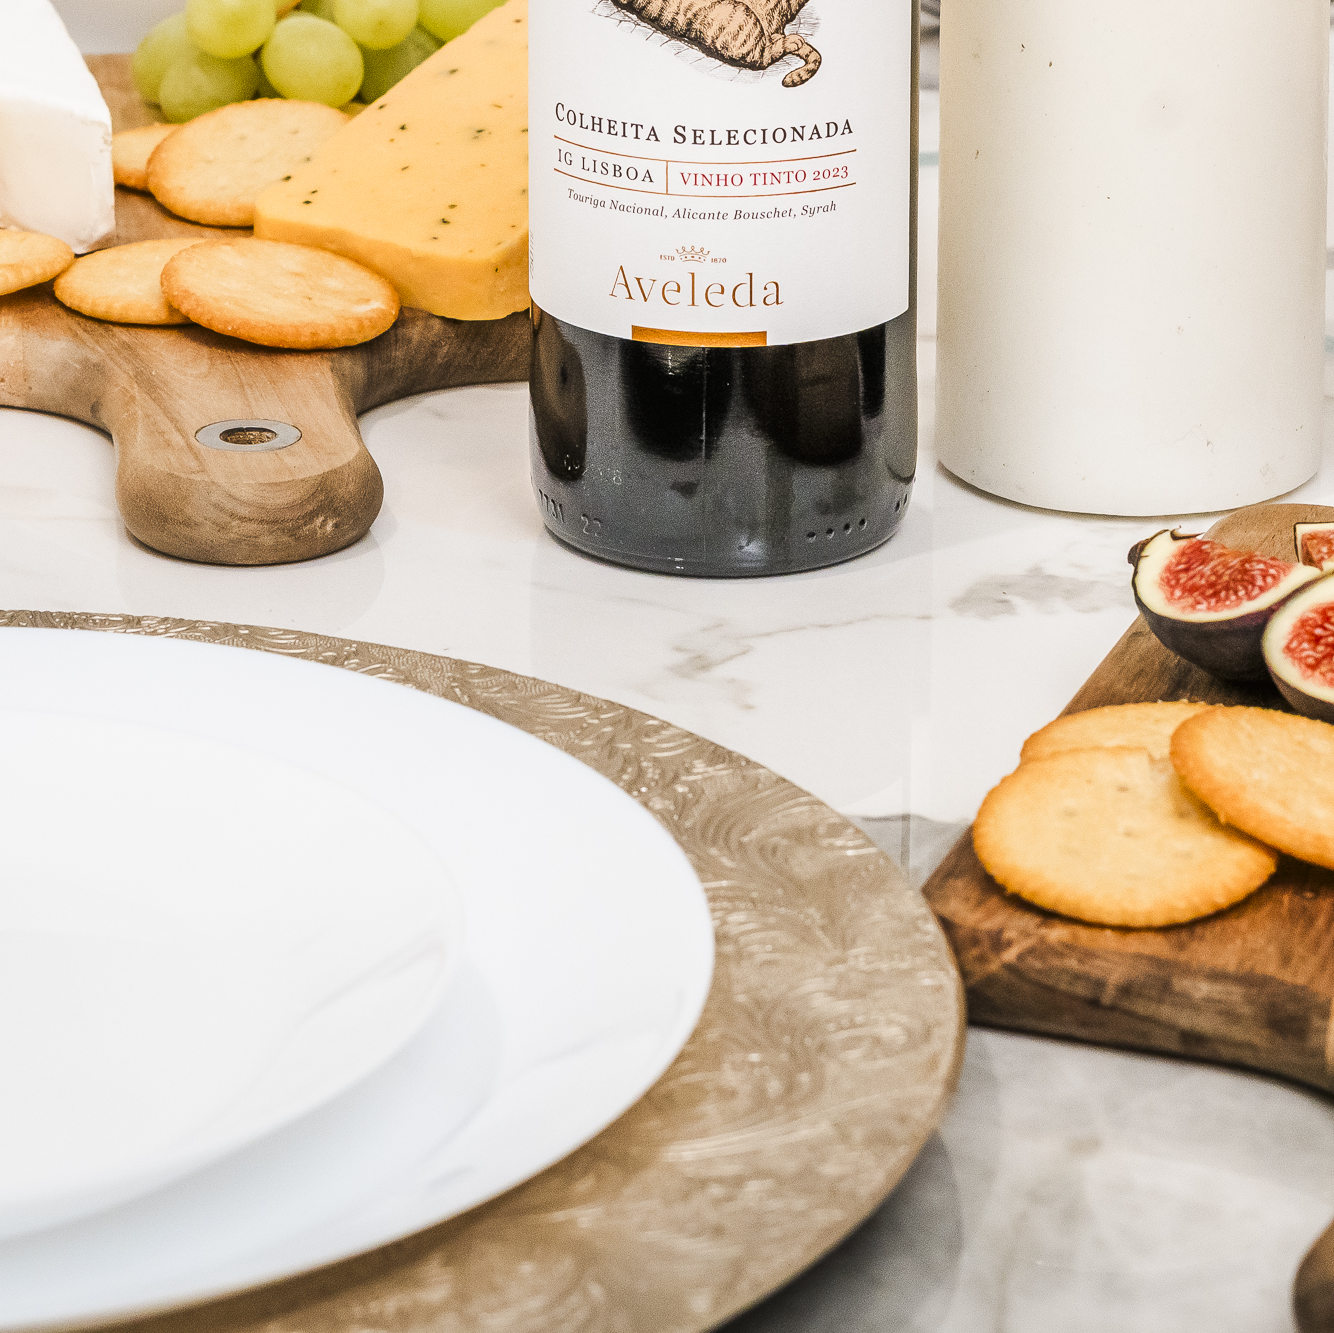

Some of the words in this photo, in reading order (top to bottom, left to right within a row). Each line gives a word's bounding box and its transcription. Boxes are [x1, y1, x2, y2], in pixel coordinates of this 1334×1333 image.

[554, 103, 660, 143] COLHEITA
[673, 118, 854, 145] SELECIONADA
[557, 148, 573, 166] IG
[581, 156, 655, 184] LISBOA
[679, 171, 744, 187] VINHO
[749, 169, 807, 187] TINTO
[812, 165, 849, 181] 2023
[567, 188, 606, 209] Touriga
[609, 199, 668, 220] Nacional,
[671, 207, 729, 221] Alicante
[733, 207, 797, 220] Bouschet,
[800, 200, 837, 218] Syrah
[608, 264, 785, 308] Aveleda
